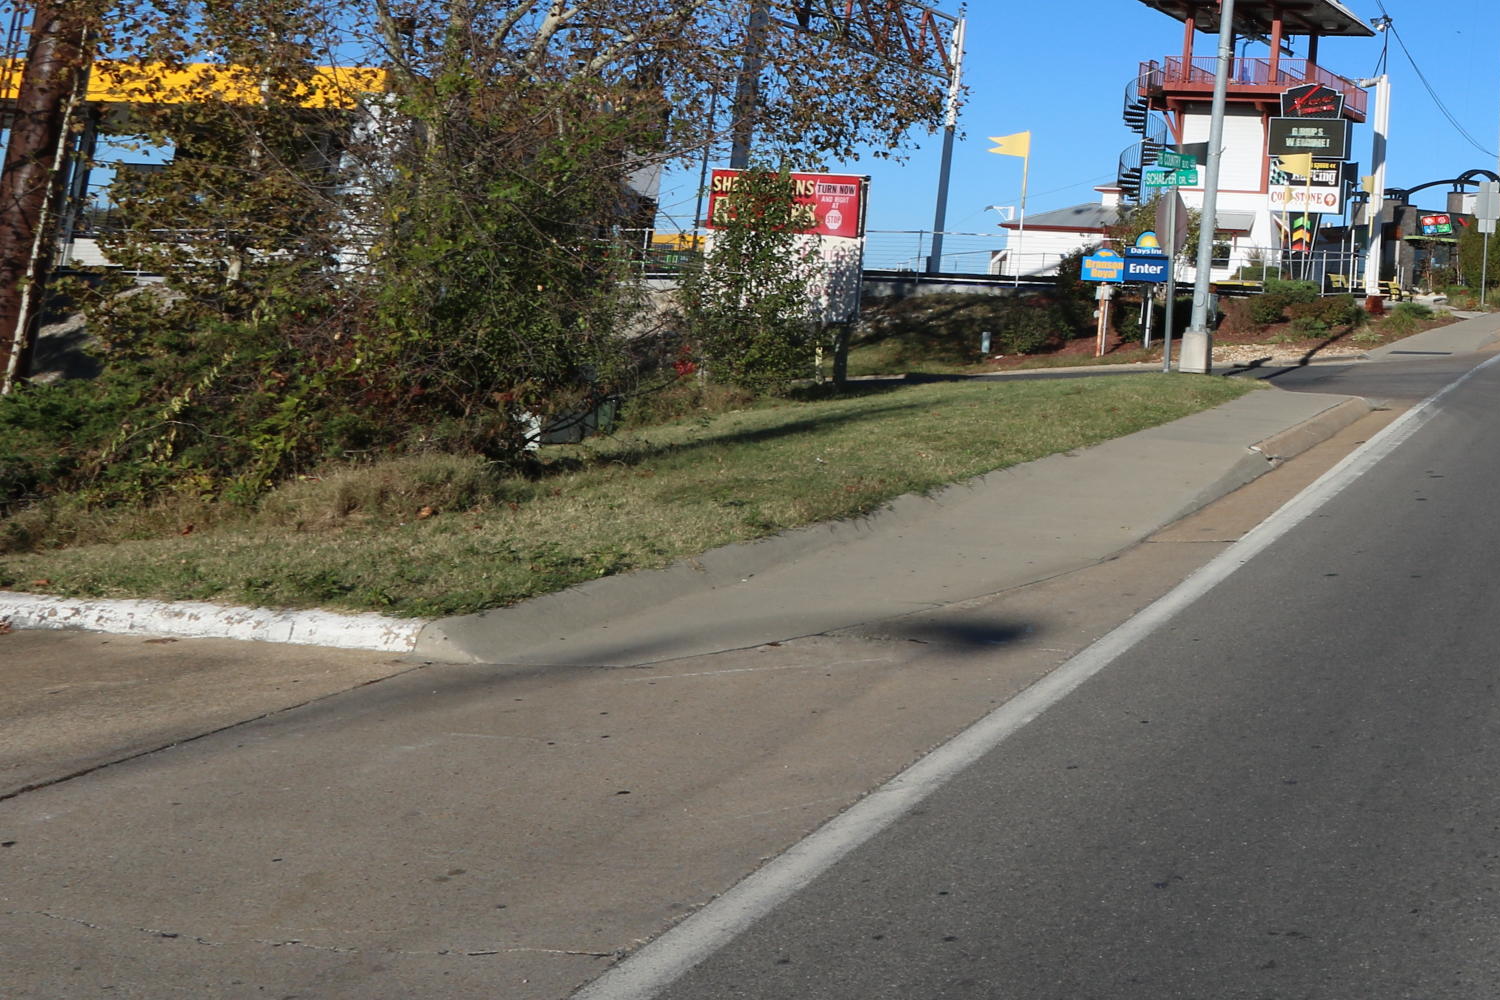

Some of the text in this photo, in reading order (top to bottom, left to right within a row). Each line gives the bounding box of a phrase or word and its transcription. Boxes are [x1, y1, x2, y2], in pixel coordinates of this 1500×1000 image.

[817, 184, 837, 194] TURN
[839, 185, 855, 195] NOW
[826, 213, 841, 224] STOP
[1129, 263, 1163, 274] Enter
